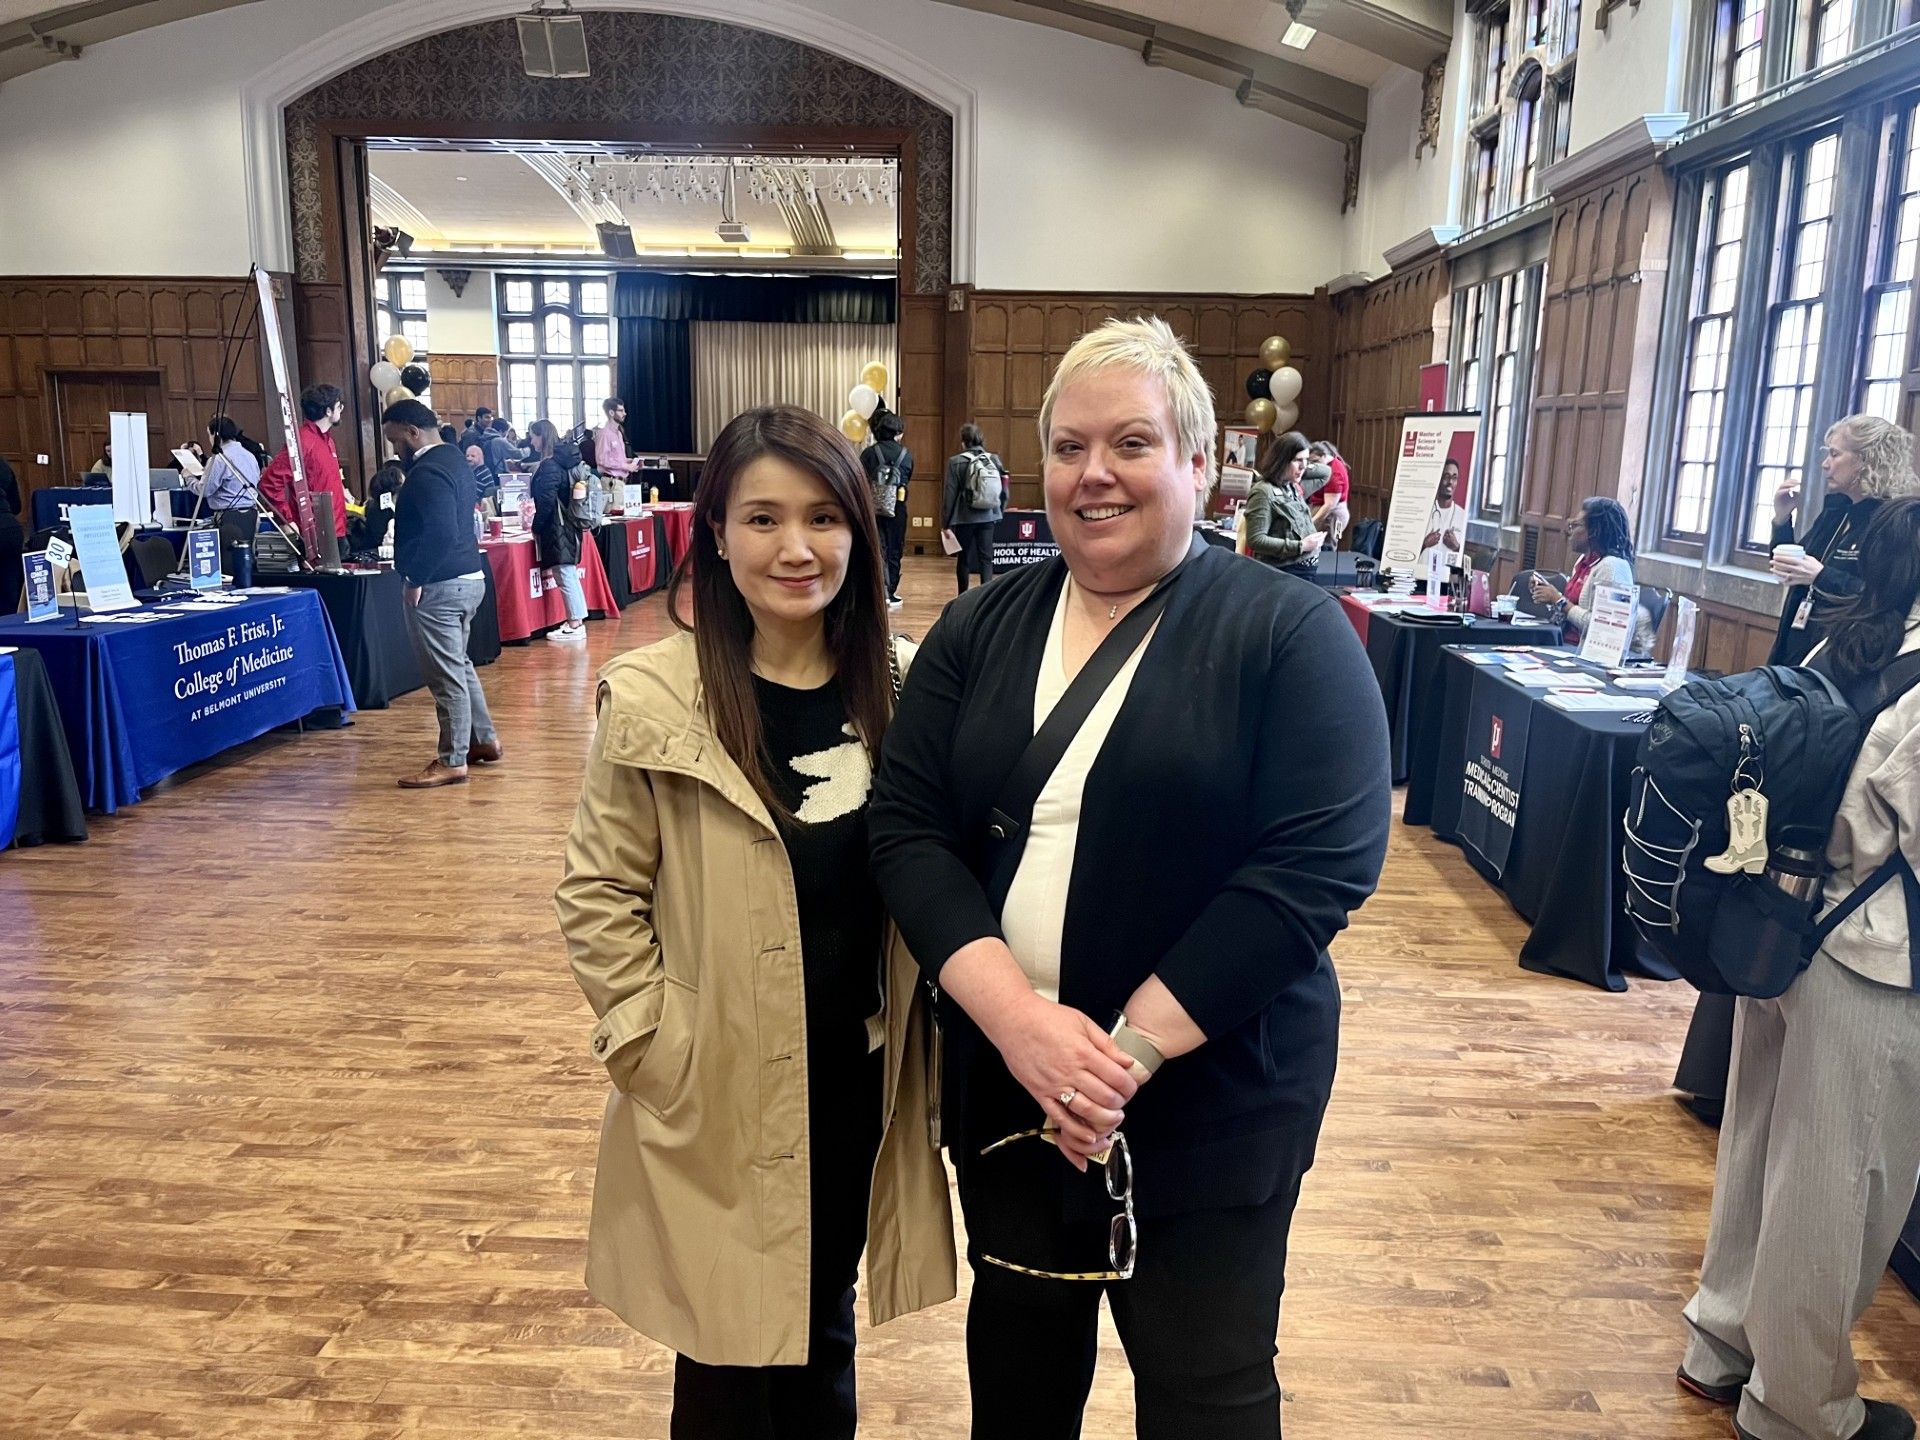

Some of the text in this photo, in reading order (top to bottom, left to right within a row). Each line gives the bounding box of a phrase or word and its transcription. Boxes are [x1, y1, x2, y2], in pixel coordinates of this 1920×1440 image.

[993, 548, 1016, 556] HOOL
[1017, 547, 1029, 556] OF
[173, 613, 286, 665] Thomas F. Frist, Jr.
[174, 645, 295, 700] College of Medicine
[190, 676, 287, 722] AT BELMONT UNIVERSITY
